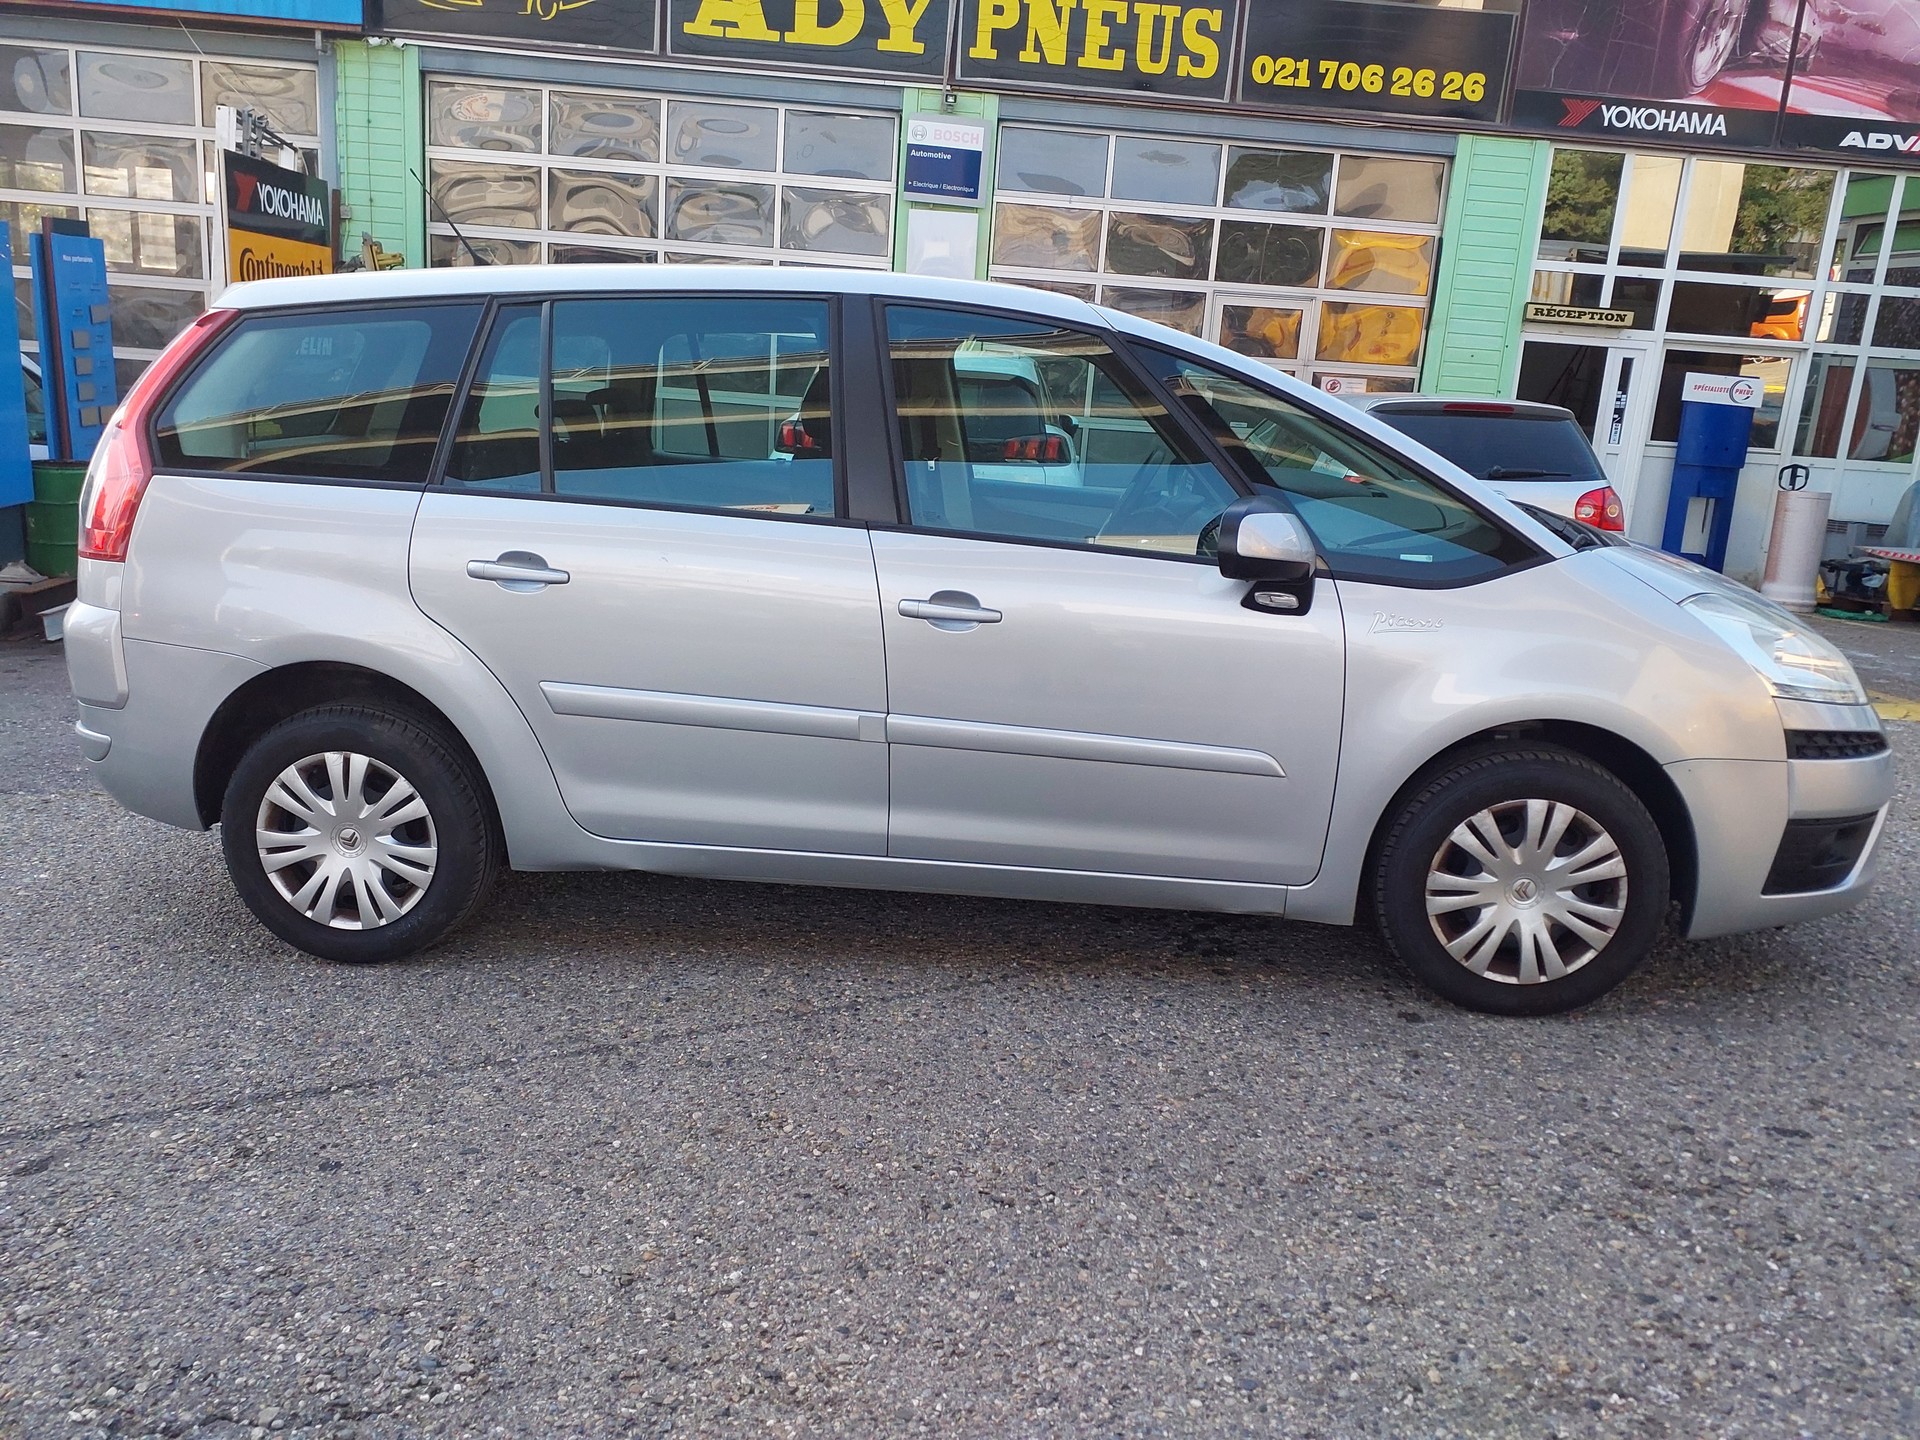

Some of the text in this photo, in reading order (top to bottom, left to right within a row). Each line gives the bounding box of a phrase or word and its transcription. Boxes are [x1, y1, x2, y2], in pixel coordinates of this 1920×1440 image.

[683, 0, 1223, 79] ADY PNEUS
[1252, 55, 1486, 102] 021 706 26 26
[1601, 104, 1727, 137] YOKOHAMA
[933, 128, 980, 145] BOSCH
[910, 149, 952, 160] Automotive
[256, 181, 325, 227] YOKOHAMA
[1533, 305, 1628, 323] RÉCEPTION
[1734, 387, 1754, 396] PNEUS
